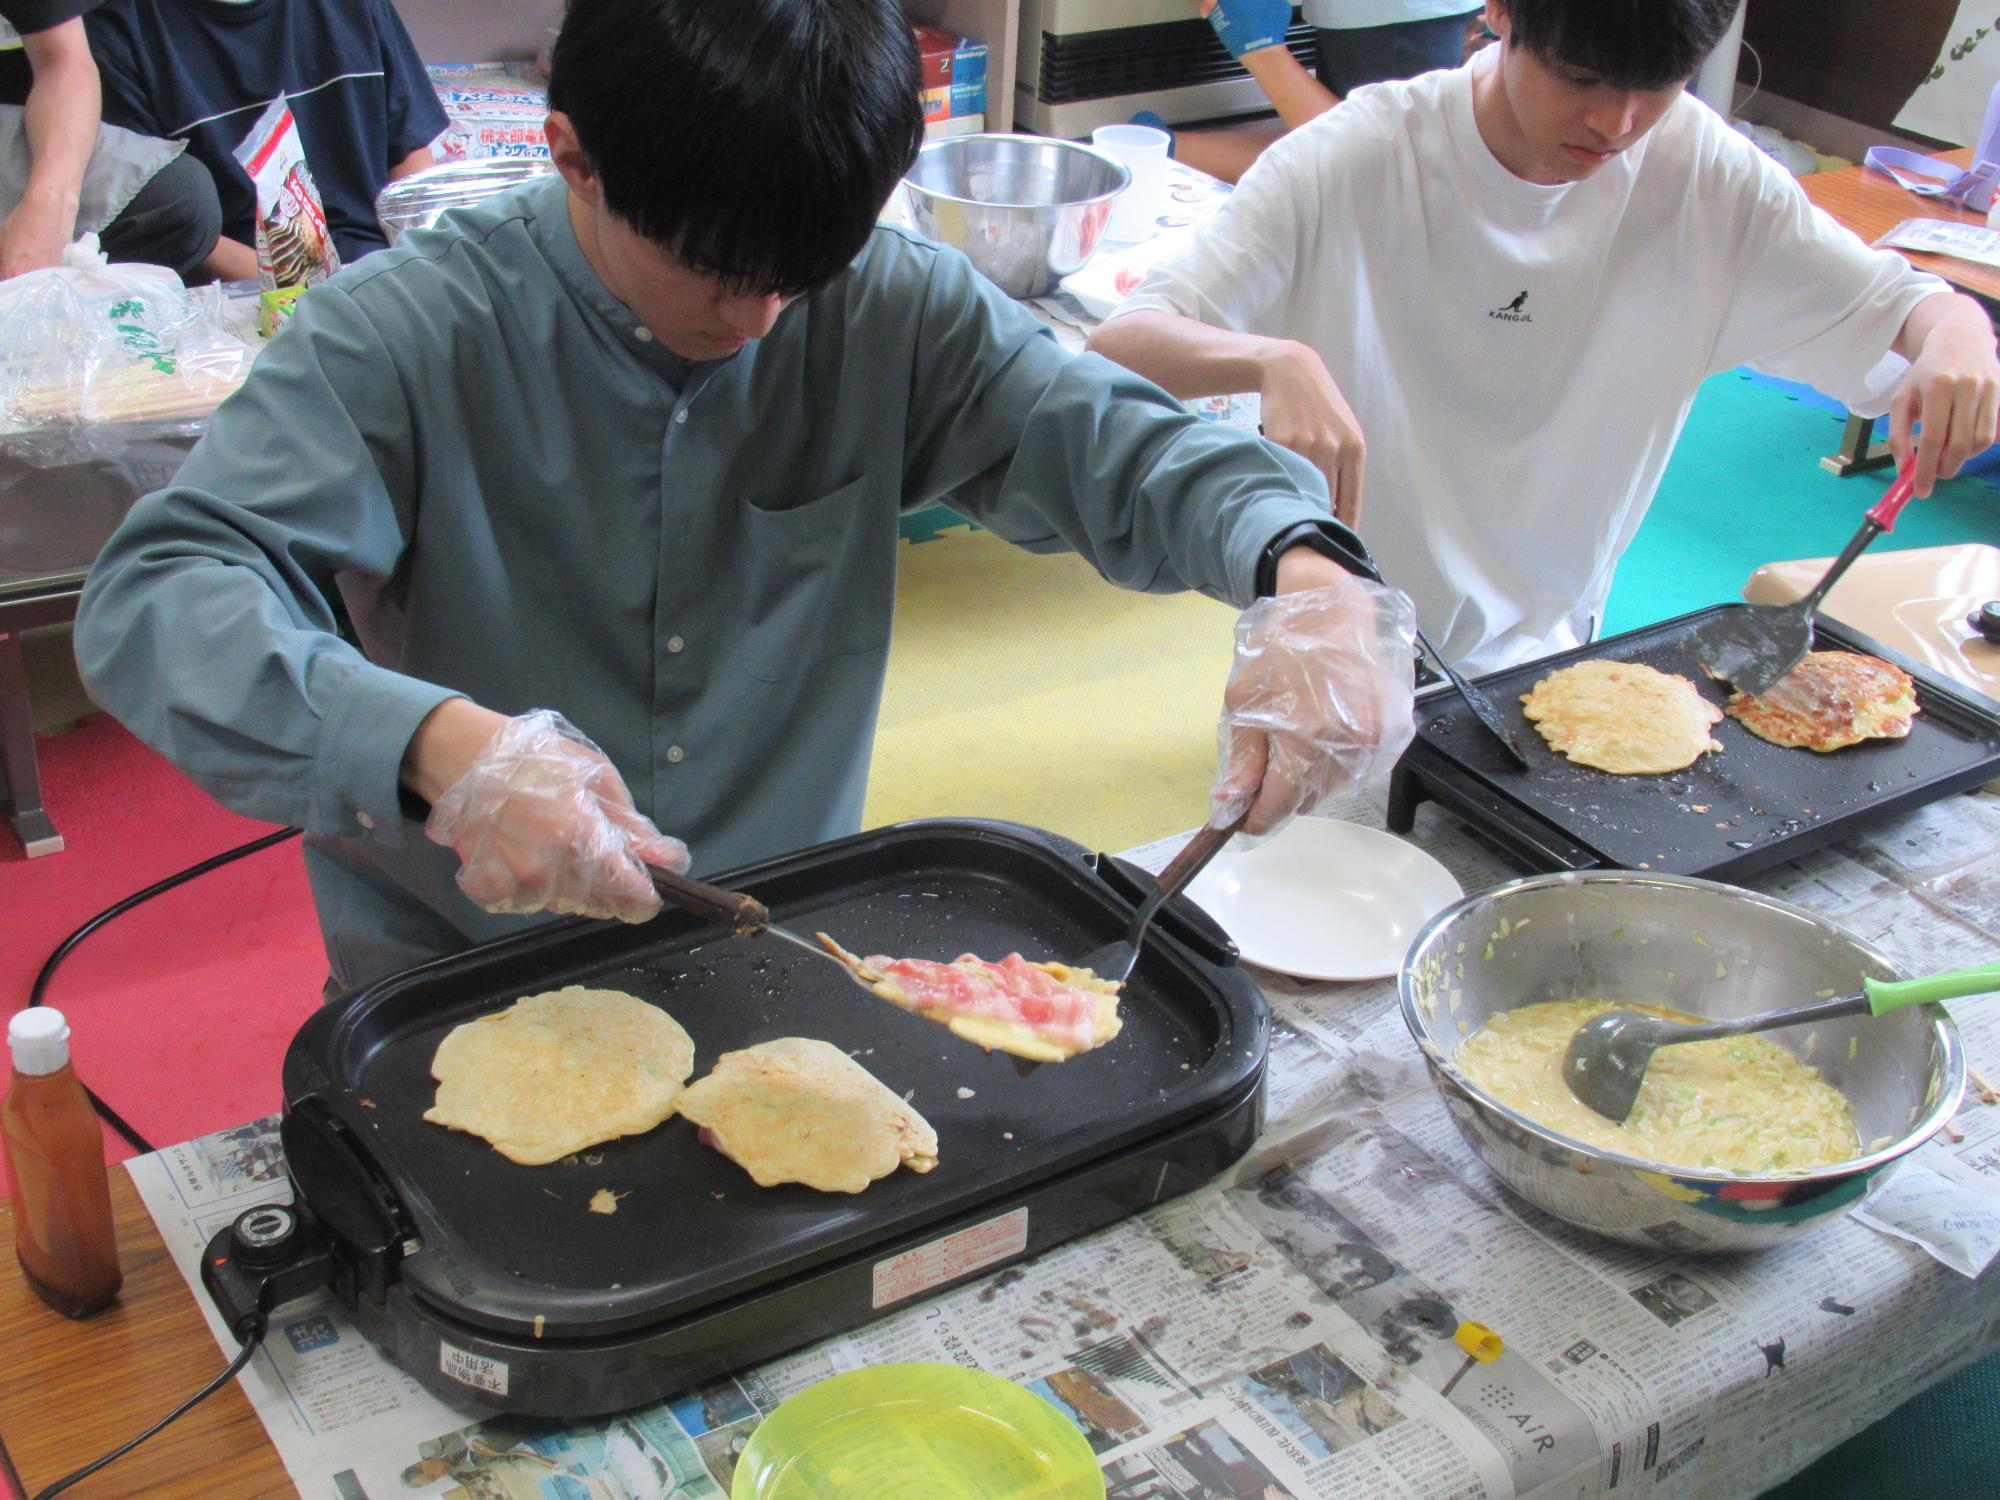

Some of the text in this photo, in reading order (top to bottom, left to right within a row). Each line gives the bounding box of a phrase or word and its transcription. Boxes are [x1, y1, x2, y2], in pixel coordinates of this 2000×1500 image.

[1489, 311, 1533, 322] KANGOL
[453, 1352, 494, 1375] 活用中
[446, 1360, 501, 1391] 不要物品
